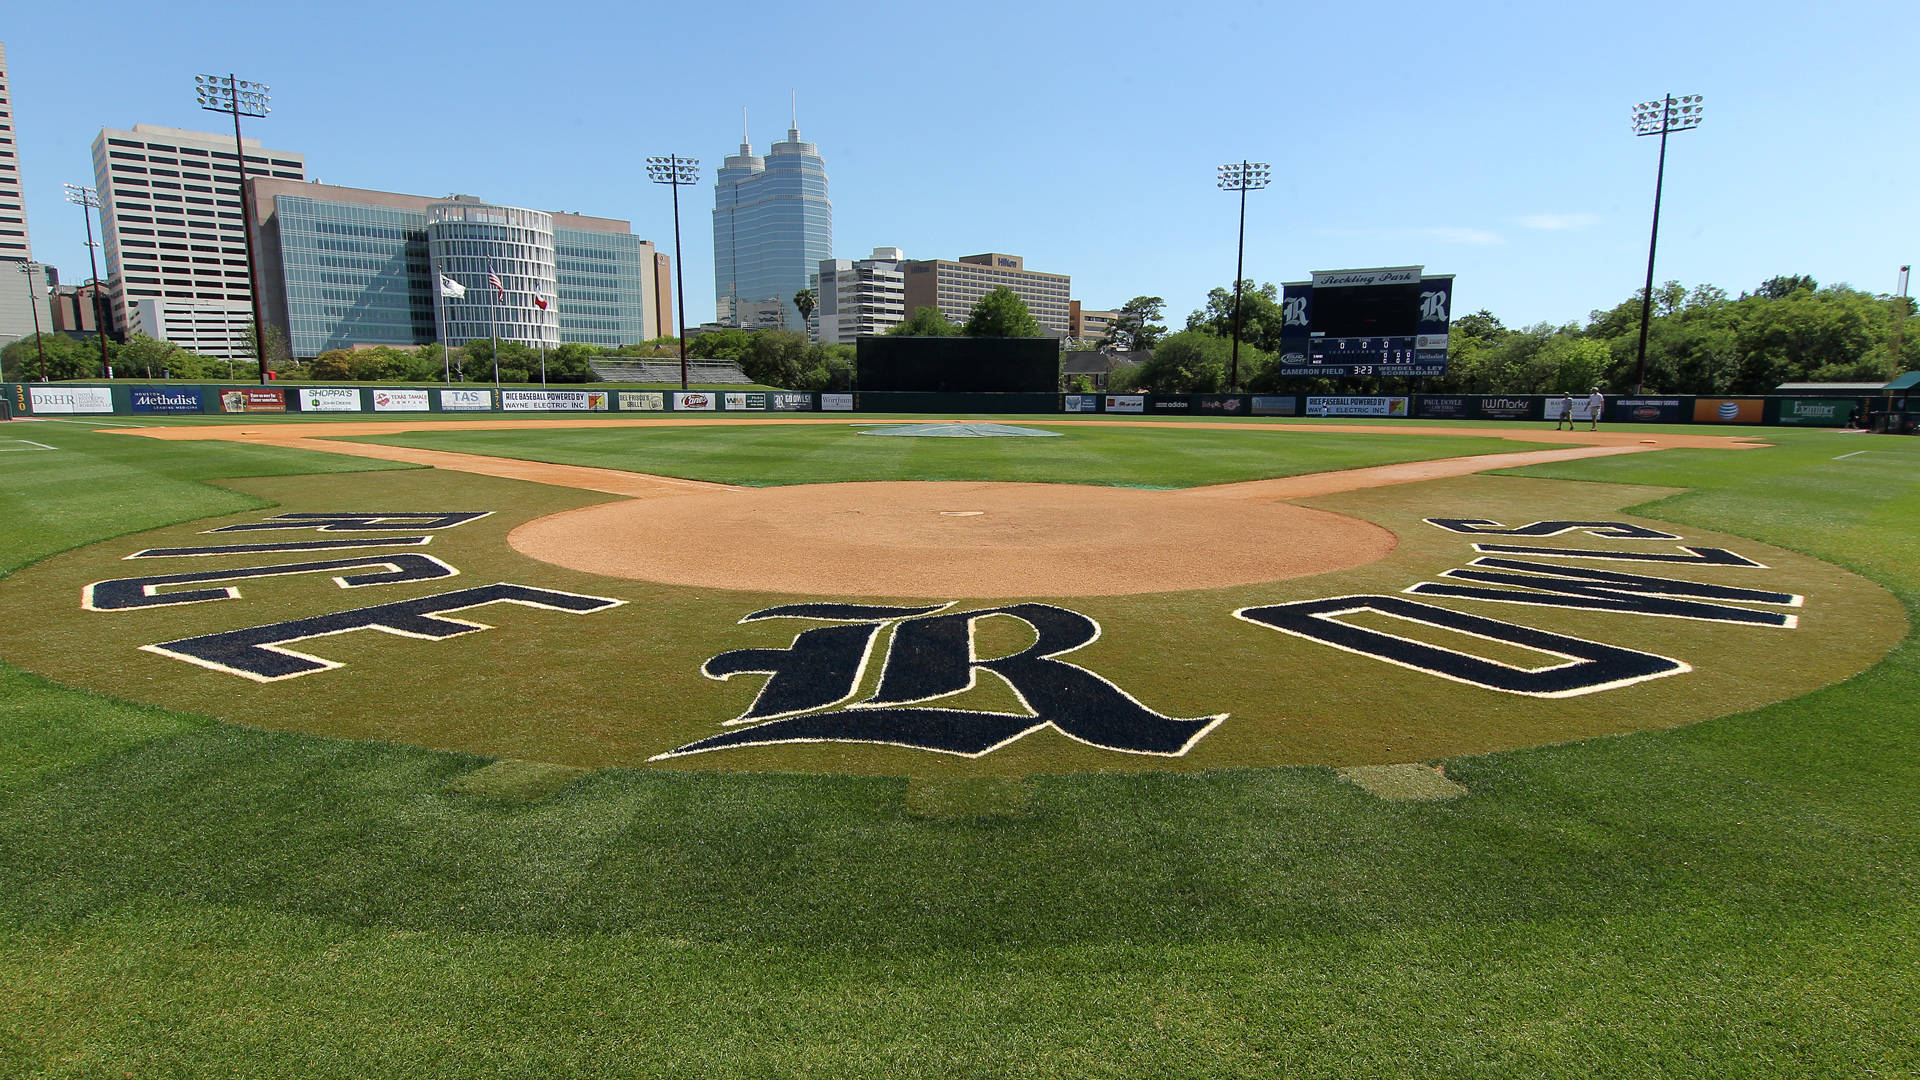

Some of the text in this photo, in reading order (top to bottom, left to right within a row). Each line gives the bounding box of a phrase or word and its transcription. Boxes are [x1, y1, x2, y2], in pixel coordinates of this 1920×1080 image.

[998, 258, 1017, 268] Hilton
[1320, 272, 1413, 285] Reckling Park
[1284, 297, 1309, 327] R
[1420, 291, 1448, 323] R
[1354, 365, 1373, 375] 3:23
[16, 384, 26, 411] 330
[32, 394, 76, 405] DRHR
[136, 393, 197, 405] Methodist
[452, 392, 479, 402] TAS
[505, 393, 584, 401] RICE BASEBALL POWERED BY
[645, 600, 1230, 762] R
